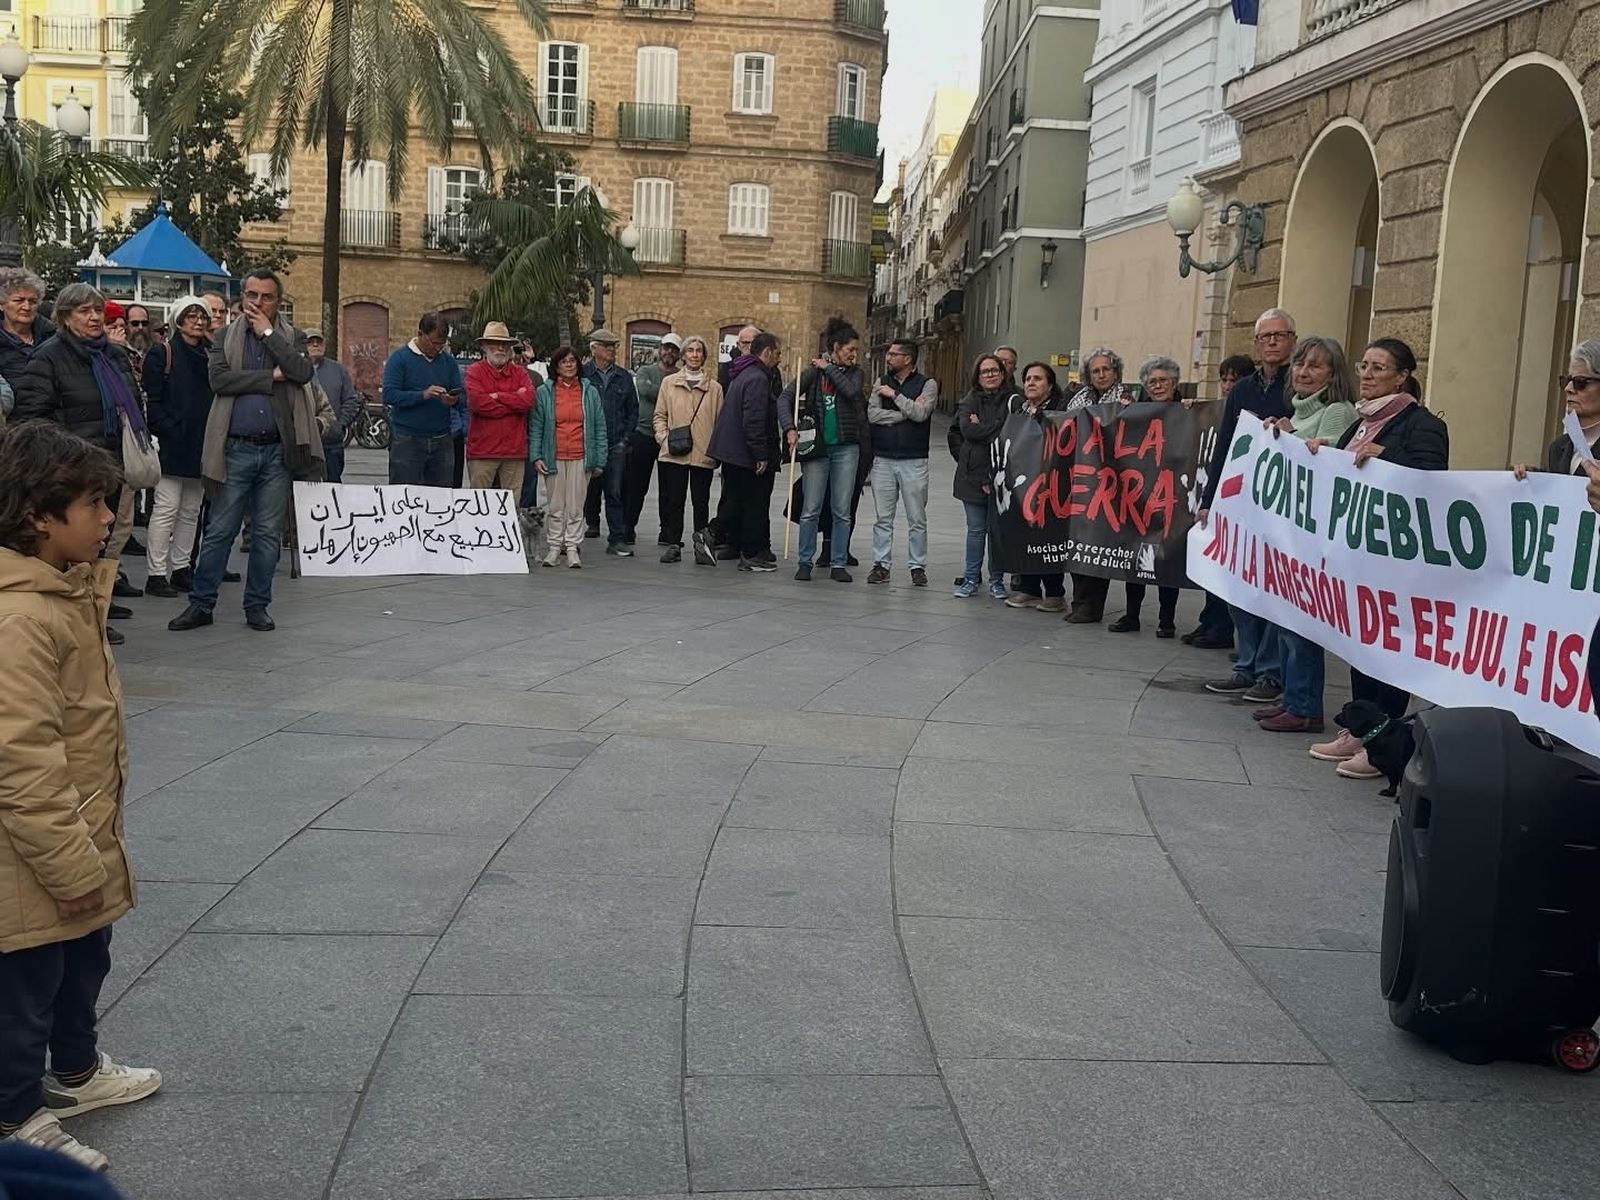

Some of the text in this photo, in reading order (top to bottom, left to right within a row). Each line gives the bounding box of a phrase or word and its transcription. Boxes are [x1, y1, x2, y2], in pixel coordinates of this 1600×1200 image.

[1044, 416, 1166, 467] NO A LA
[392, 487, 425, 515] على
[425, 490, 490, 526] للحرب
[495, 491, 509, 516] لا
[1022, 463, 1178, 540] GUERRA
[422, 526, 446, 554] مع
[449, 521, 522, 562] التطبيع
[1294, 463, 1317, 534] EL
[1328, 475, 1487, 570] PUEBLO
[1511, 501, 1560, 584] DE
[1570, 510, 1600, 594] I
[1072, 551, 1131, 570] Andalucía
[1203, 512, 1229, 566] NO
[1229, 523, 1239, 575] A
[1242, 529, 1258, 588] LA
[1264, 543, 1351, 637] AGRESIÓN
[1357, 585, 1402, 652] DE
[1411, 596, 1508, 688] EE.UU.
[1514, 622, 1536, 695] E
